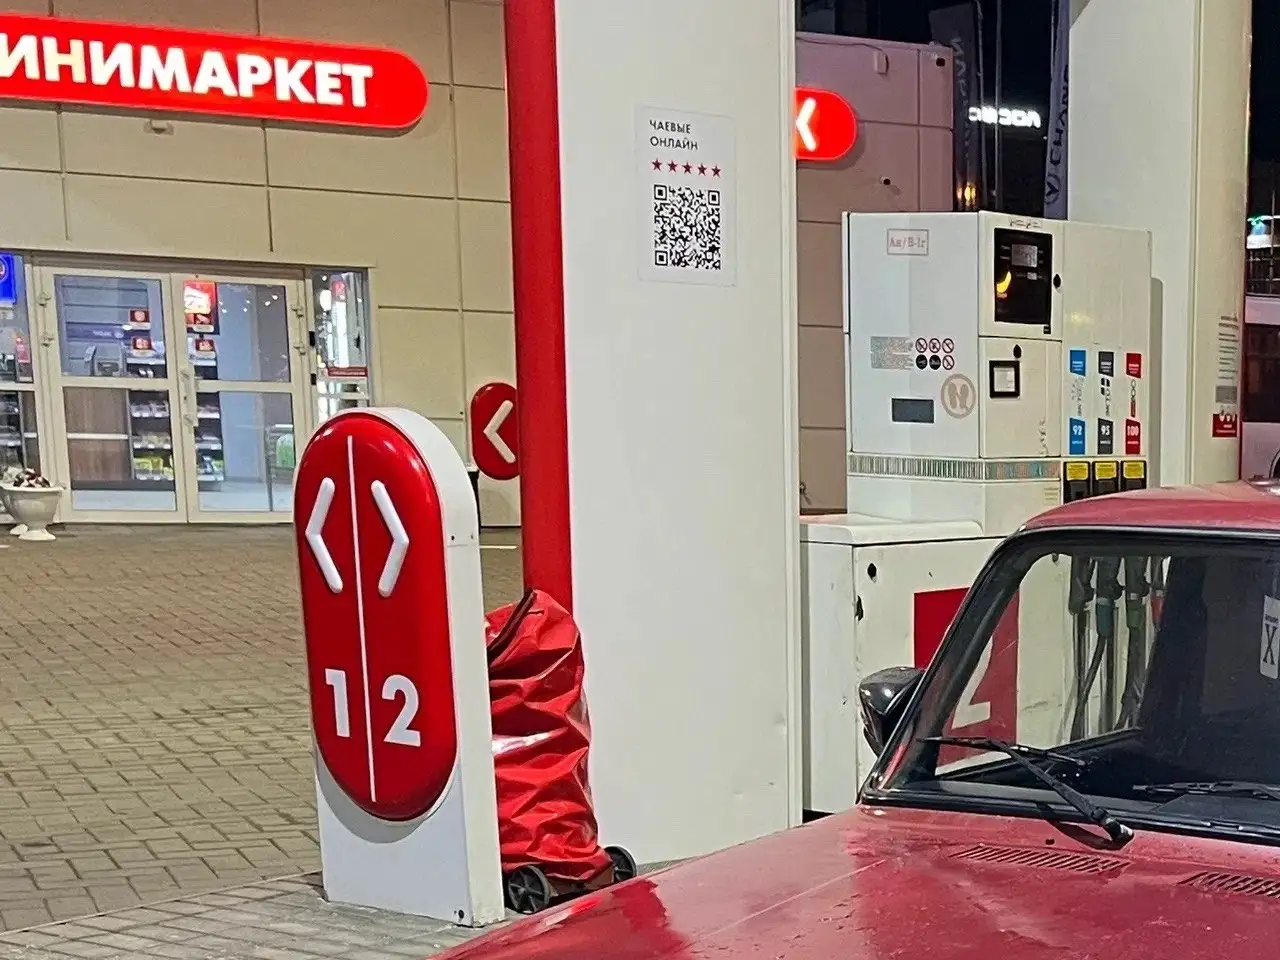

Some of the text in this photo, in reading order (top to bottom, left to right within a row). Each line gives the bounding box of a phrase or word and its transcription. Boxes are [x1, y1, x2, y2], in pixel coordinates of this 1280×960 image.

[649, 119, 691, 134] ЧАЕВЫЕ
[649, 136, 698, 150] ОНЛАЙН
[1072, 425, 1083, 436] 92
[1100, 425, 1110, 436] 95
[1126, 425, 1139, 437] 100
[324, 668, 350, 738] 1
[381, 674, 421, 747] 2
